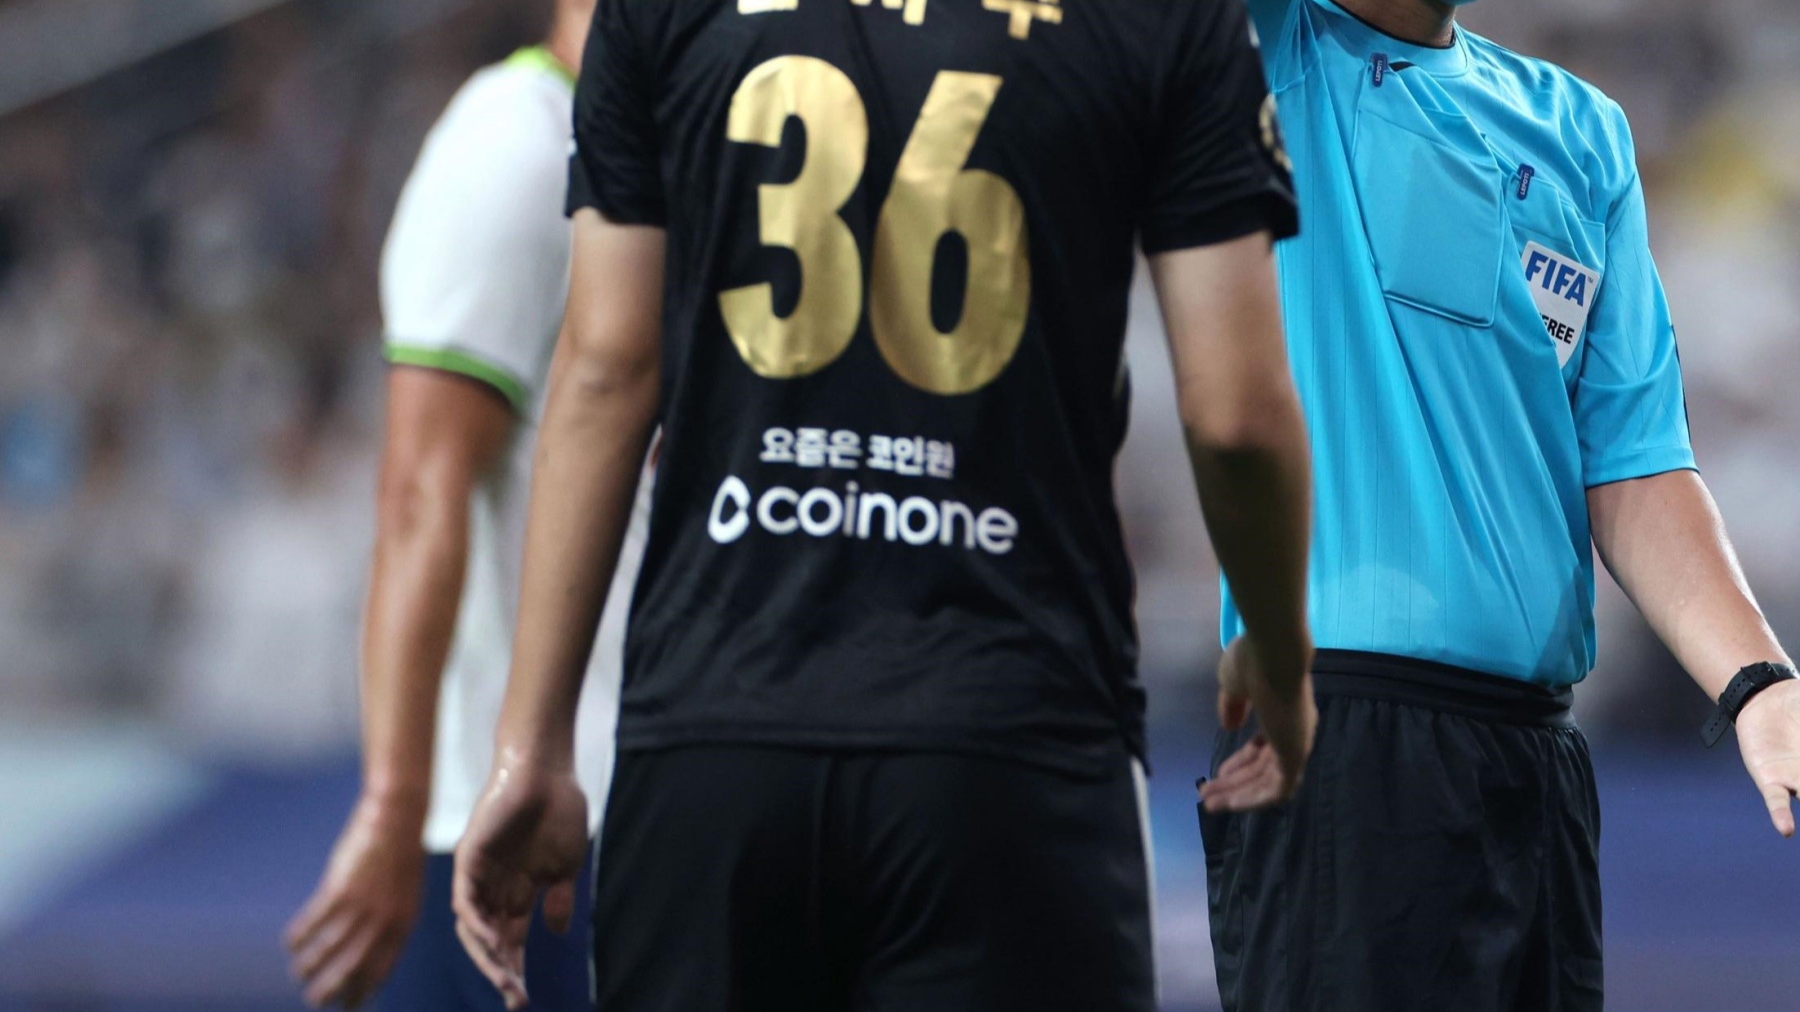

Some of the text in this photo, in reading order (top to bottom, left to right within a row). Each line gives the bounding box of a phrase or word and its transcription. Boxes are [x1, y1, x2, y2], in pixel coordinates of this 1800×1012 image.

[717, 54, 1031, 396] 36
[1525, 250, 1587, 308] FIFA
[759, 427, 955, 479] 요즘은 코인원
[757, 480, 1018, 555] coinone
